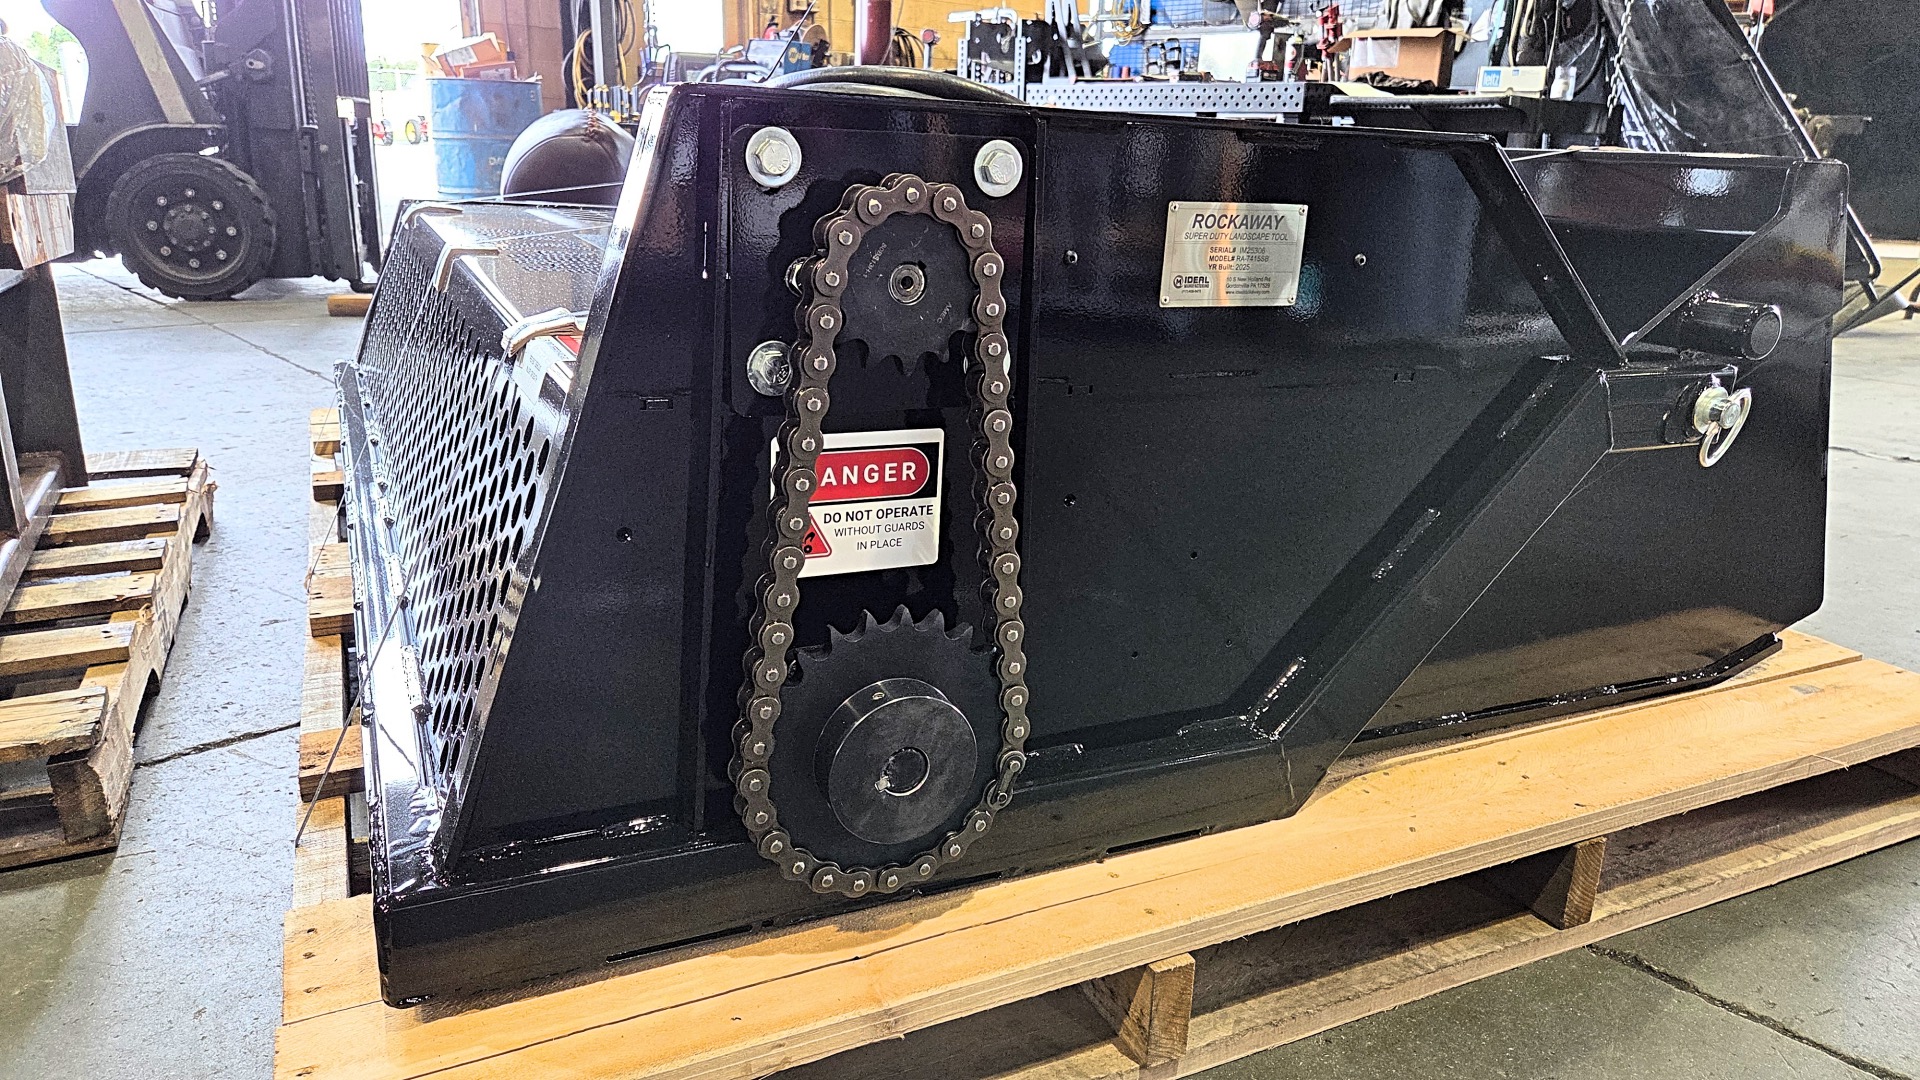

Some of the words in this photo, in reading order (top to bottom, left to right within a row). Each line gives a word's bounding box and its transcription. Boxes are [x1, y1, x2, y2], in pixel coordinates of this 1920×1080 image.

[1192, 213, 1285, 230] ROCKAWAY
[1184, 231, 1208, 240] SUPER
[1209, 232, 1229, 240] DUTY
[1229, 232, 1270, 241] LANDSCAPE
[1271, 233, 1289, 241] TOOL
[1209, 246, 1237, 254] SERIAL#
[1218, 263, 1234, 271] Built:
[1235, 263, 1251, 271] 2025
[1184, 276, 1210, 284] IDEAL
[820, 461, 917, 486] ANGER
[823, 512, 842, 524] DO
[845, 509, 873, 522] NOT
[876, 504, 934, 520] OPERATE
[834, 524, 881, 537] WITHOUT
[884, 520, 925, 534] GUARDS
[856, 541, 867, 551] IN
[870, 537, 902, 549] PLACE
